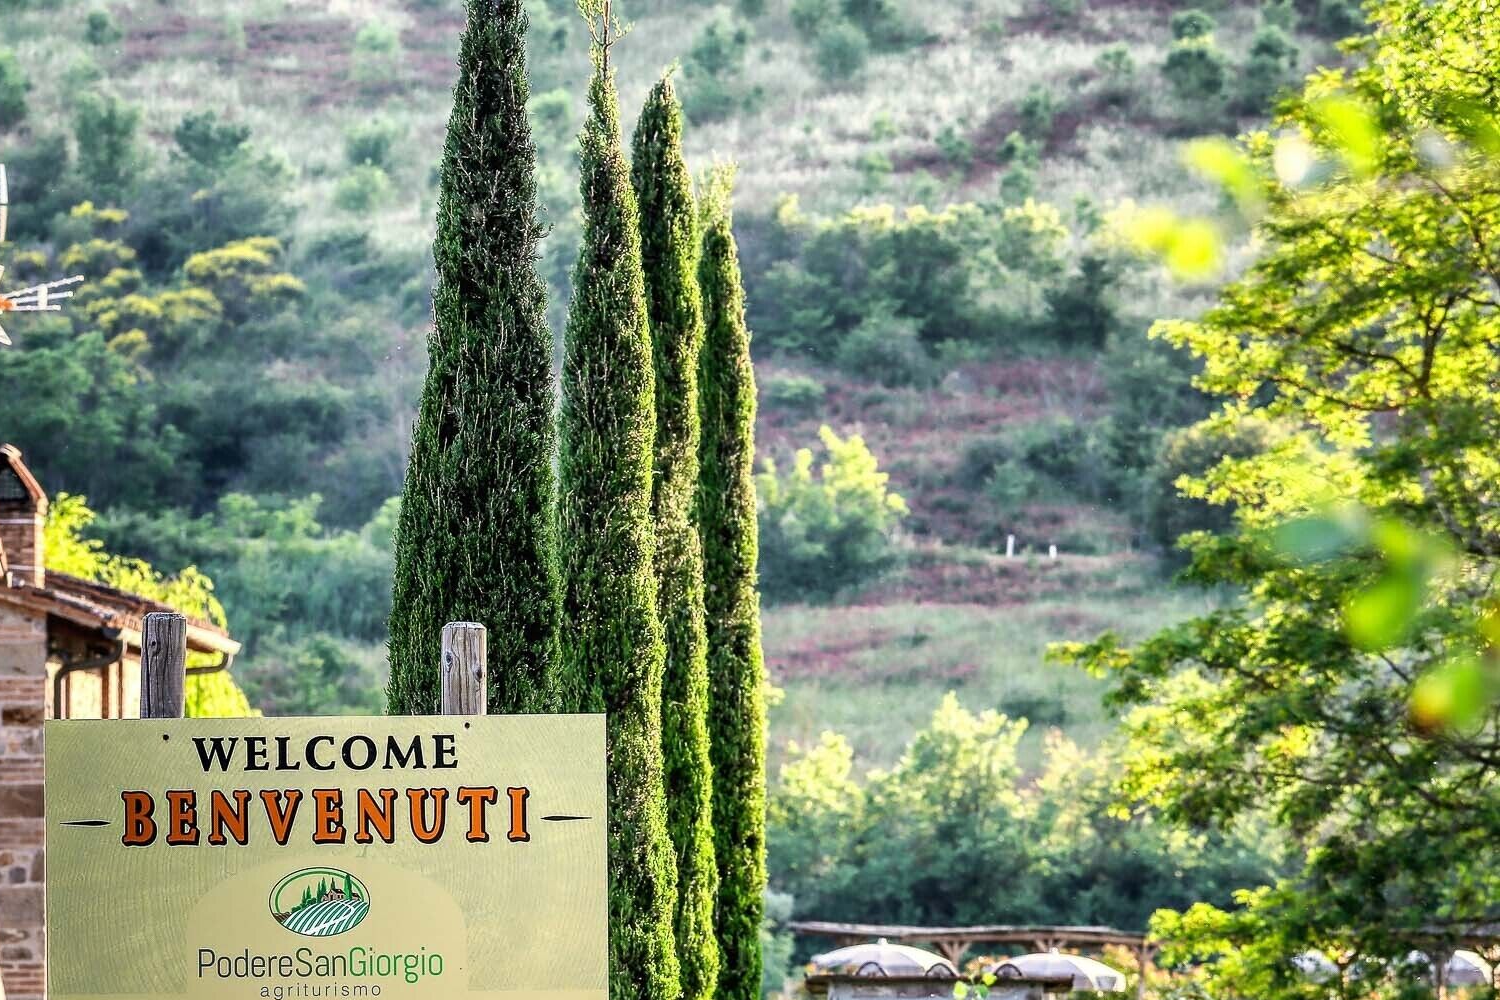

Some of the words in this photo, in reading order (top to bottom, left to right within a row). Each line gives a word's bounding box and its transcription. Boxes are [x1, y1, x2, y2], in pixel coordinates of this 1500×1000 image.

[191, 734, 459, 772] WELCOME
[121, 786, 532, 846] BENVENUTI
[197, 946, 444, 983] PodereSanGiorgio
[259, 982, 382, 1000] agriturismo
